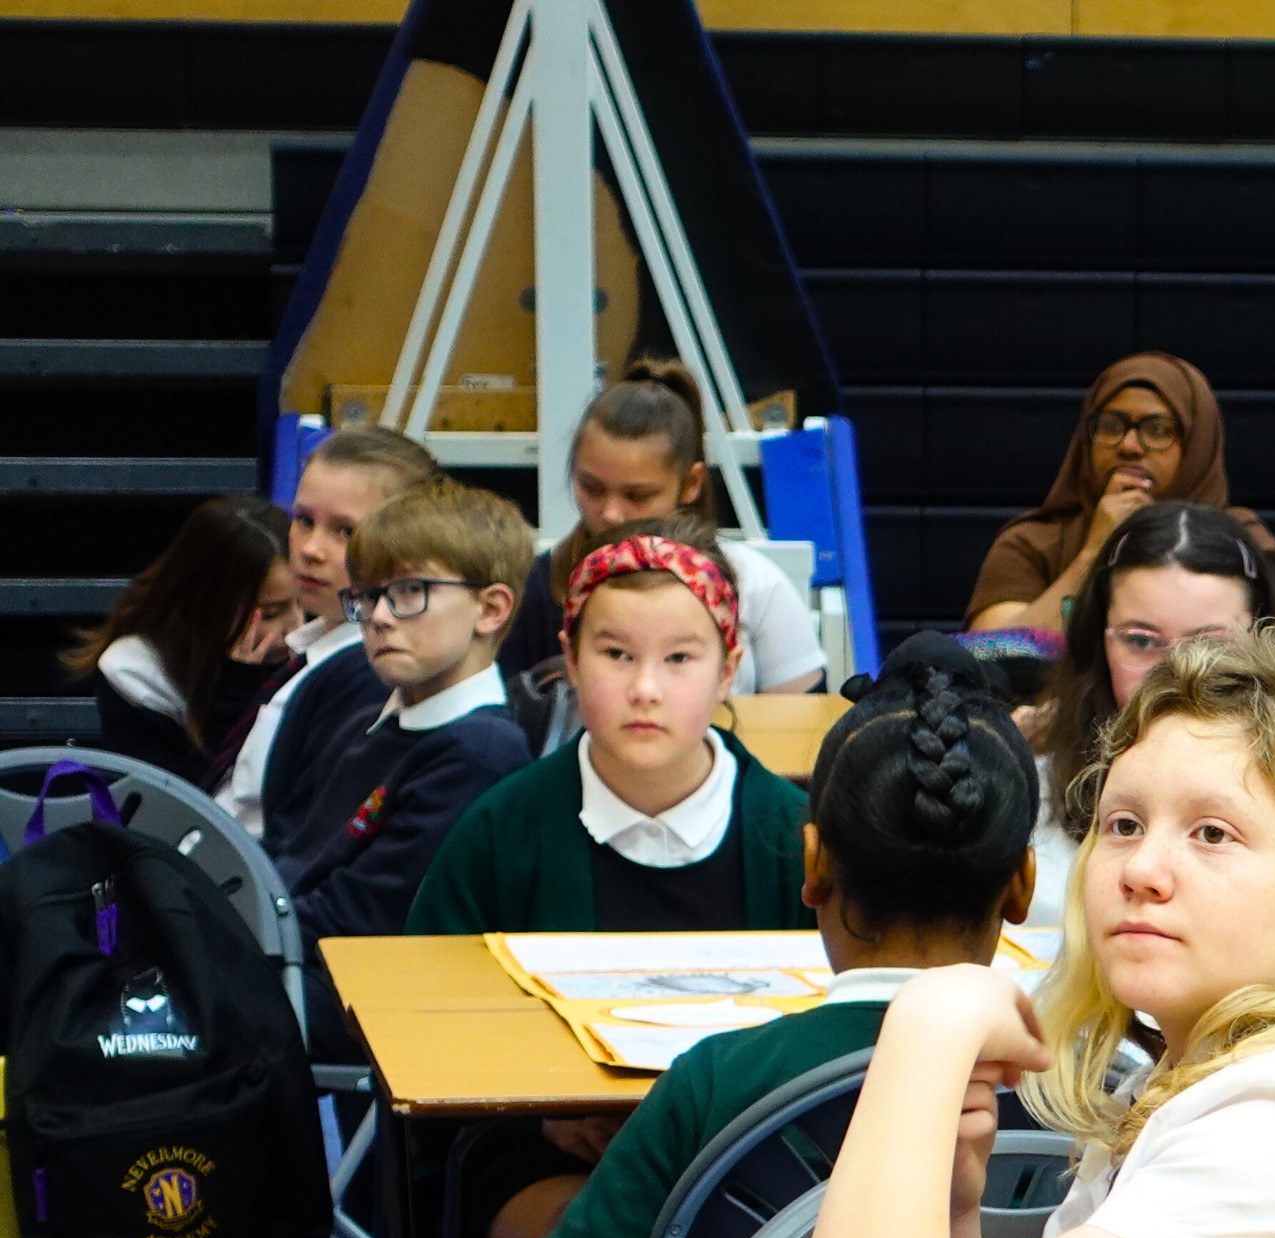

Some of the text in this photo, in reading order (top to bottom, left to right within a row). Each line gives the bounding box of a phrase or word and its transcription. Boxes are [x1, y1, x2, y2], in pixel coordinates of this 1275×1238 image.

[98, 1032, 198, 1058] WEDNESDAY
[121, 1145, 216, 1192] NEVERMORE
[159, 1175, 184, 1219] N
